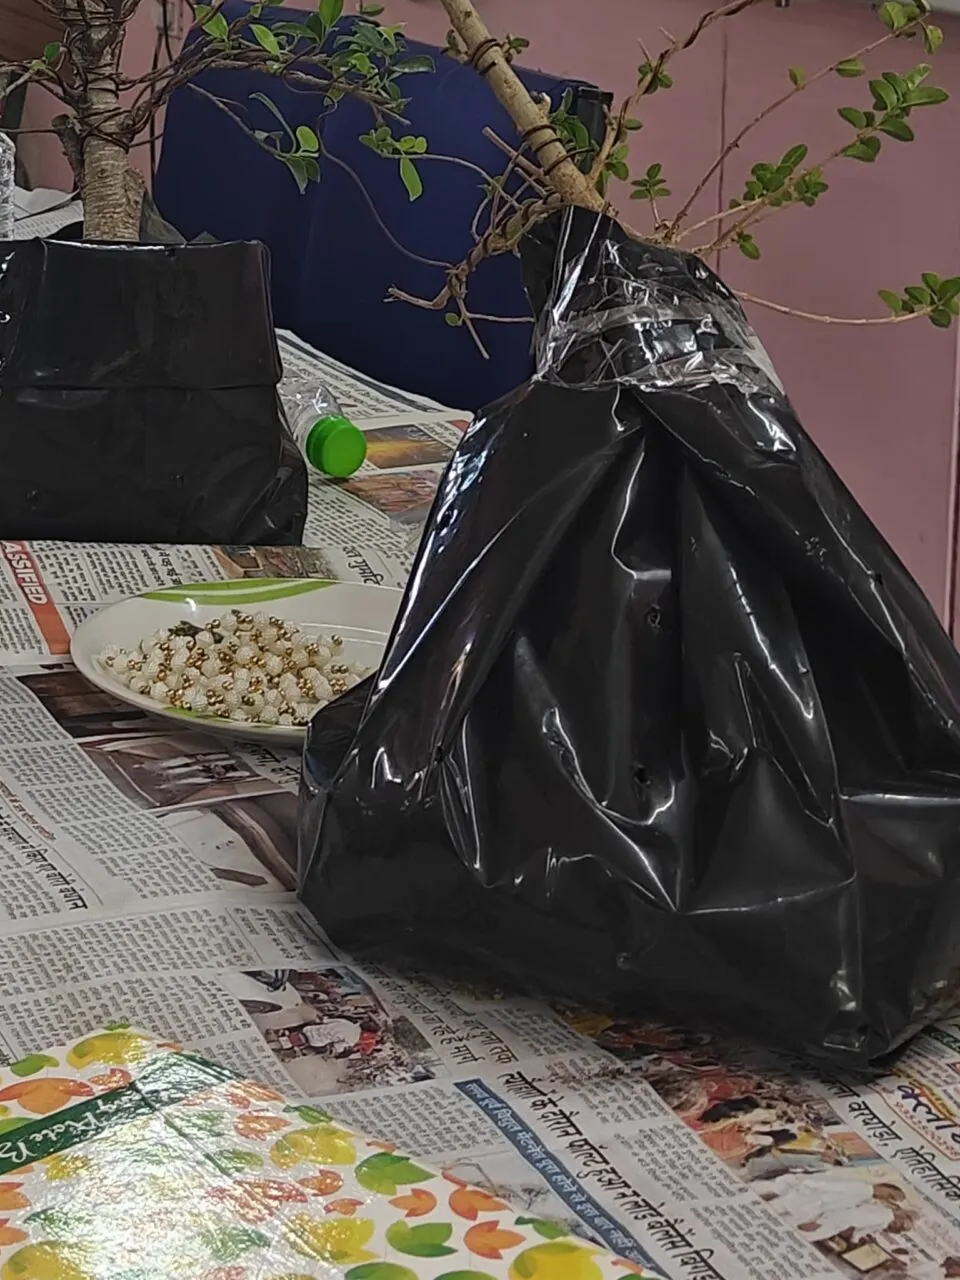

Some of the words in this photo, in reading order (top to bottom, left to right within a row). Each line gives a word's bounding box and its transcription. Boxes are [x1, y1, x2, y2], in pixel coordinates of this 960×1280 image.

[450, 1046, 486, 1065] मार्ग
[530, 1096, 564, 1111] के
[537, 1108, 581, 1138] दौरान
[551, 1174, 577, 1193] होने
[576, 1166, 632, 1191] हुआ
